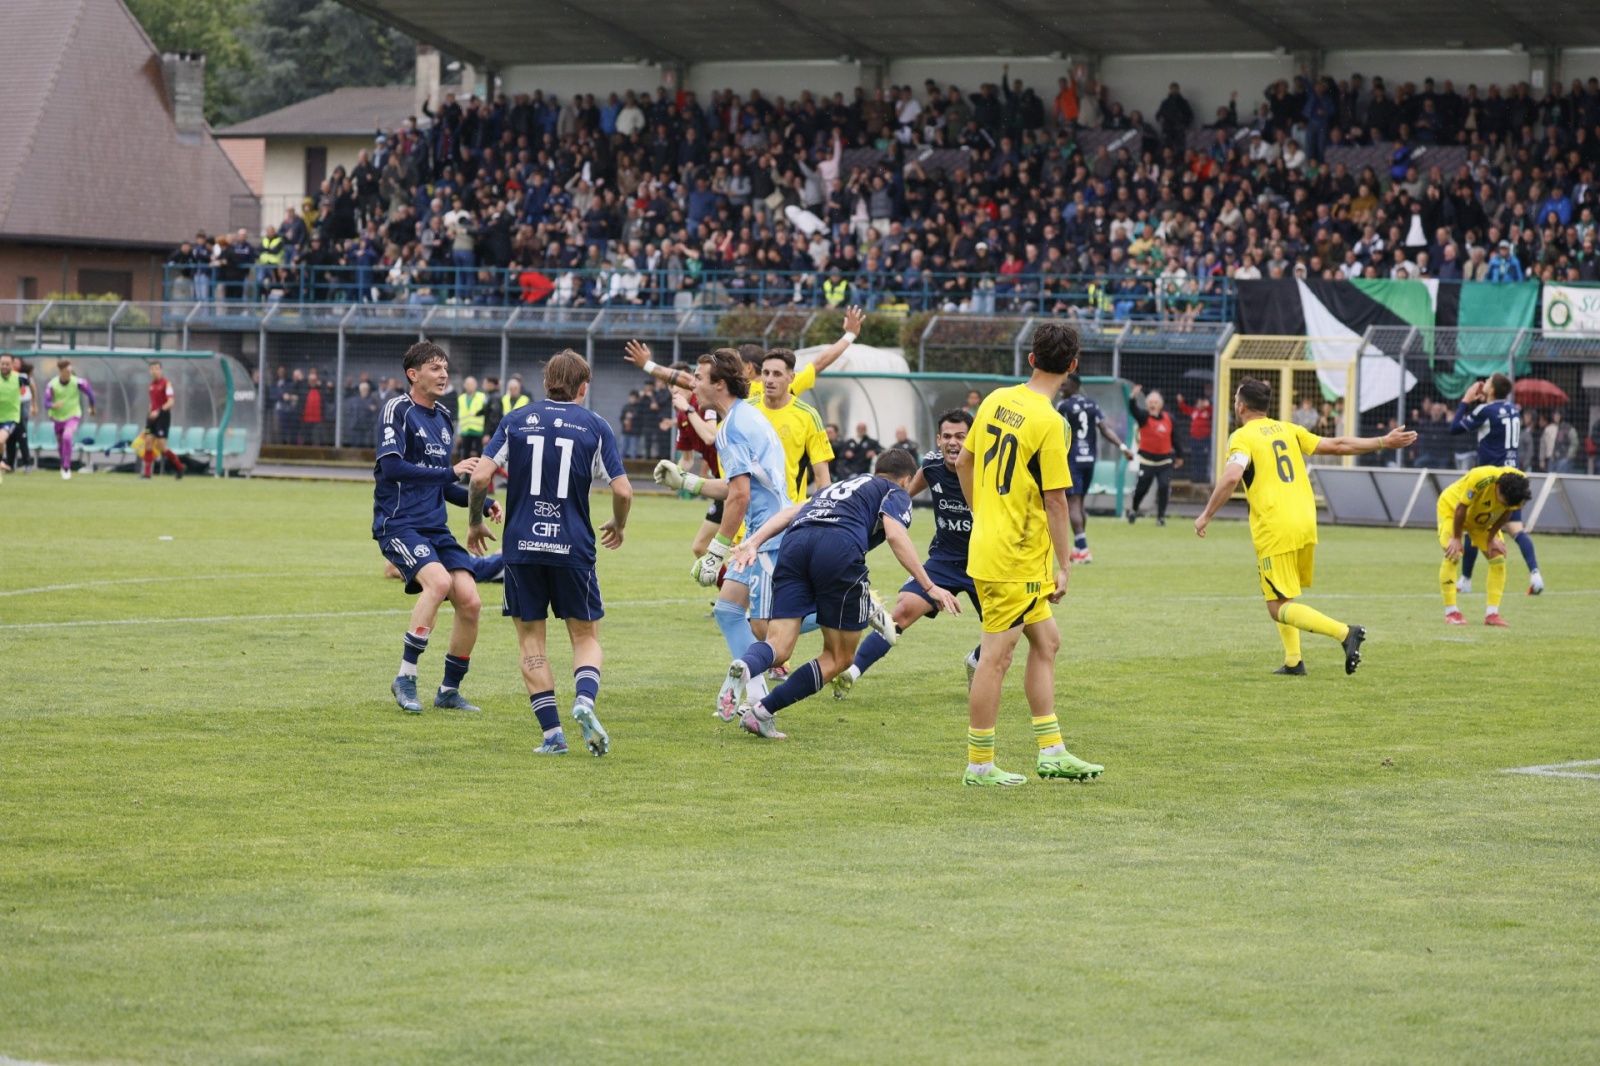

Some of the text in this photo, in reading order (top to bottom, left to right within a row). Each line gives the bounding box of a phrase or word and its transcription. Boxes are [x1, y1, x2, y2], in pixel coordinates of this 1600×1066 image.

[1077, 411, 1089, 439] 3
[1501, 417, 1520, 449] 10
[527, 435, 574, 498] 11
[982, 423, 1018, 495] 70
[1272, 440, 1295, 482] 6
[526, 541, 571, 551] CHIARAVALLI
